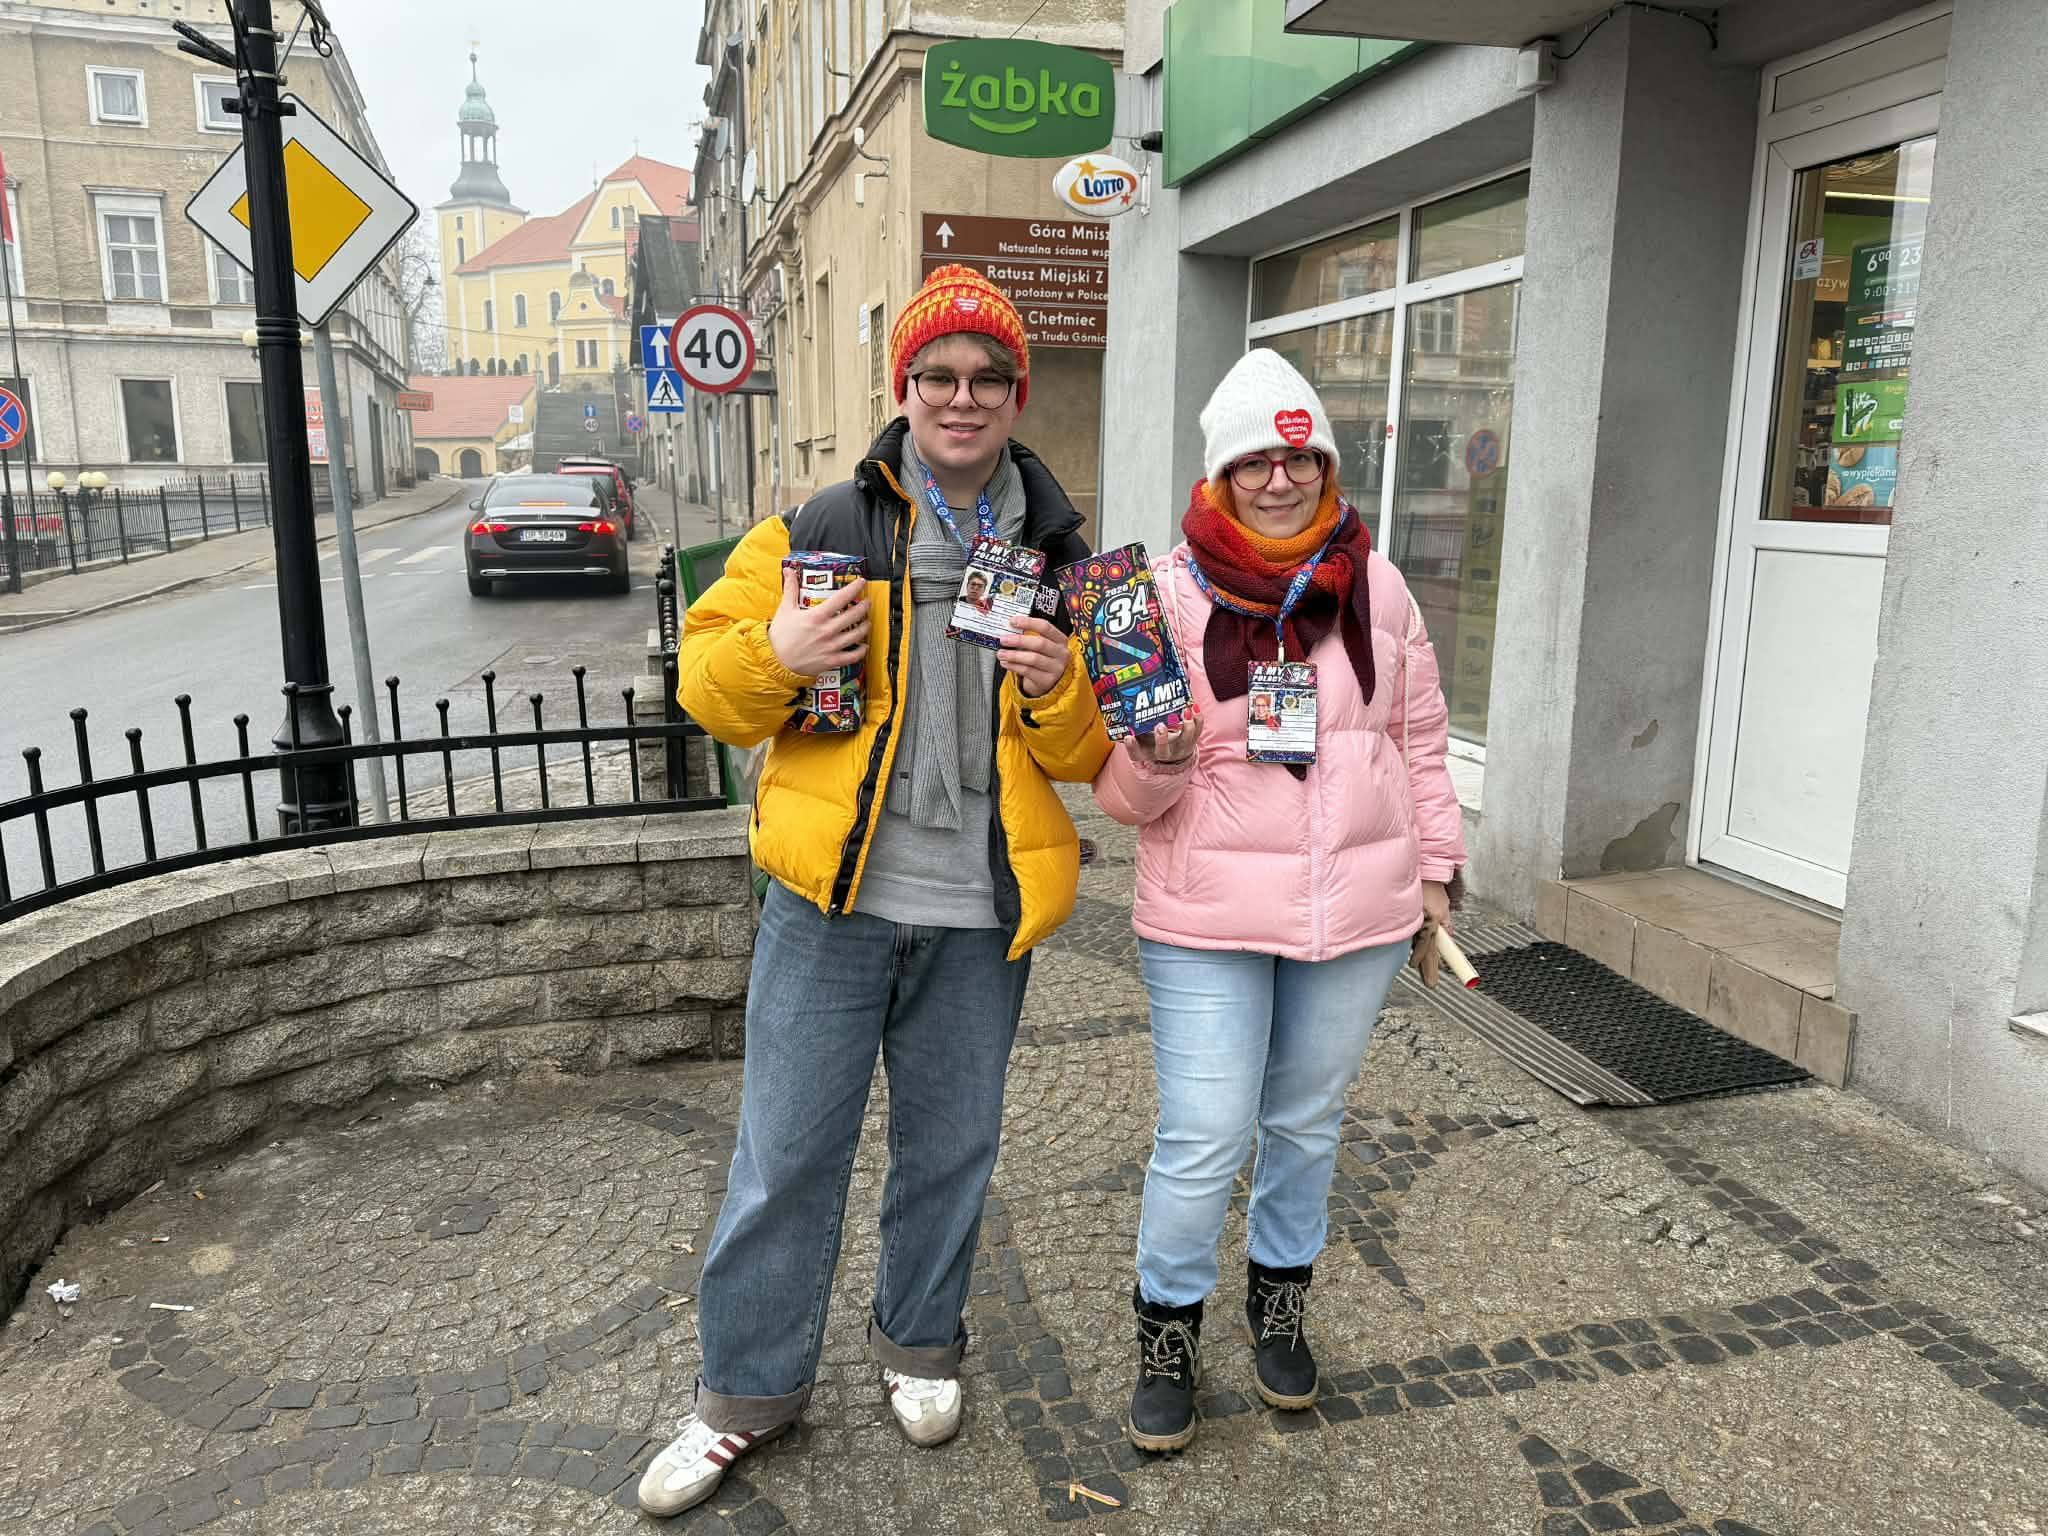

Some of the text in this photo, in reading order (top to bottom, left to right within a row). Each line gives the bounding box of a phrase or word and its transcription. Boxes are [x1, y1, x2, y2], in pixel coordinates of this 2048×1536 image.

[941, 60, 1100, 117] żabka
[1084, 177, 1124, 197] LOTTO
[1029, 223, 1066, 238] Góra
[999, 242, 1051, 255] Naturalna
[1055, 245, 1088, 256] ściana
[987, 265, 1104, 286] Ratusz Miejski Z
[1016, 287, 1062, 300] położony
[1066, 291, 1074, 299] w
[1028, 311, 1096, 327] Chełmiec
[1041, 331, 1069, 342] Trudu
[684, 328, 741, 369] 40
[978, 541, 989, 551] A
[1107, 582, 1150, 635] 34
[1135, 690, 1150, 711] A
[1154, 679, 1182, 705] MY?
